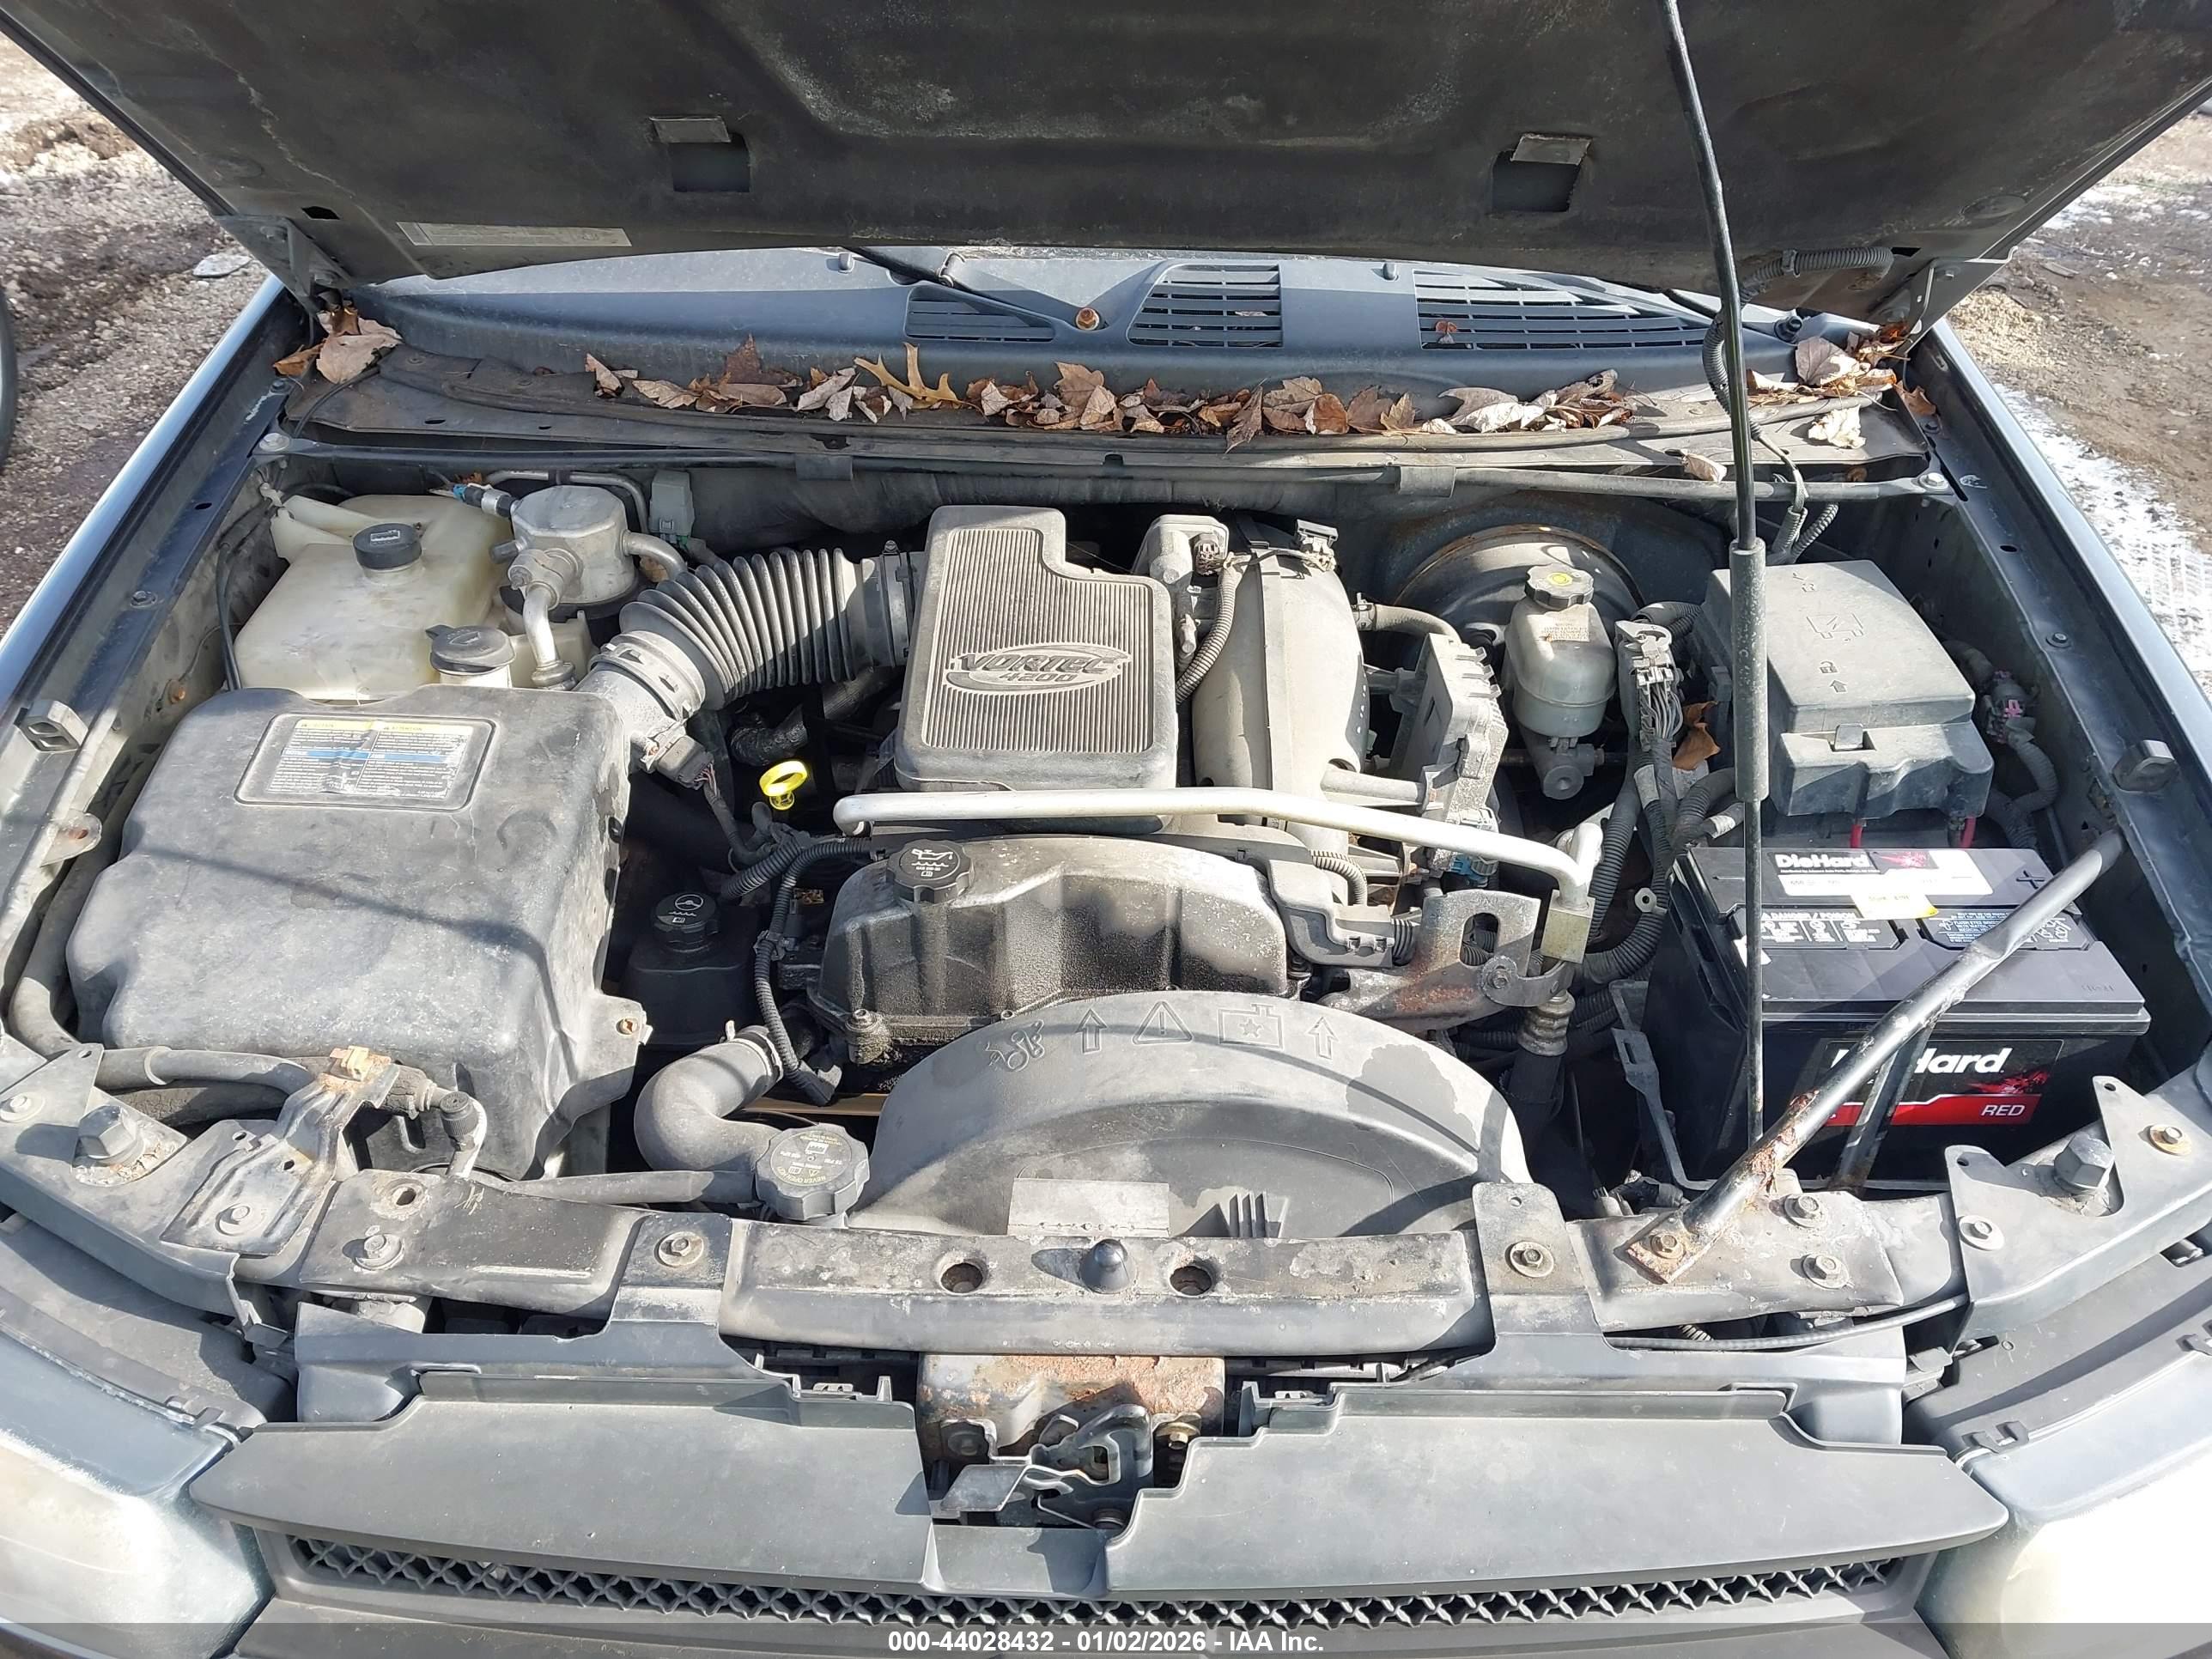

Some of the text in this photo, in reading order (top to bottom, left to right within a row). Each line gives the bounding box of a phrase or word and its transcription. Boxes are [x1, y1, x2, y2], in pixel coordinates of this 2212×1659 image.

[957, 653, 1115, 674] VORTEC
[1000, 672, 1079, 682] 4200
[1775, 854, 1872, 868] DieHard
[1980, 1104, 2026, 1116] RED
